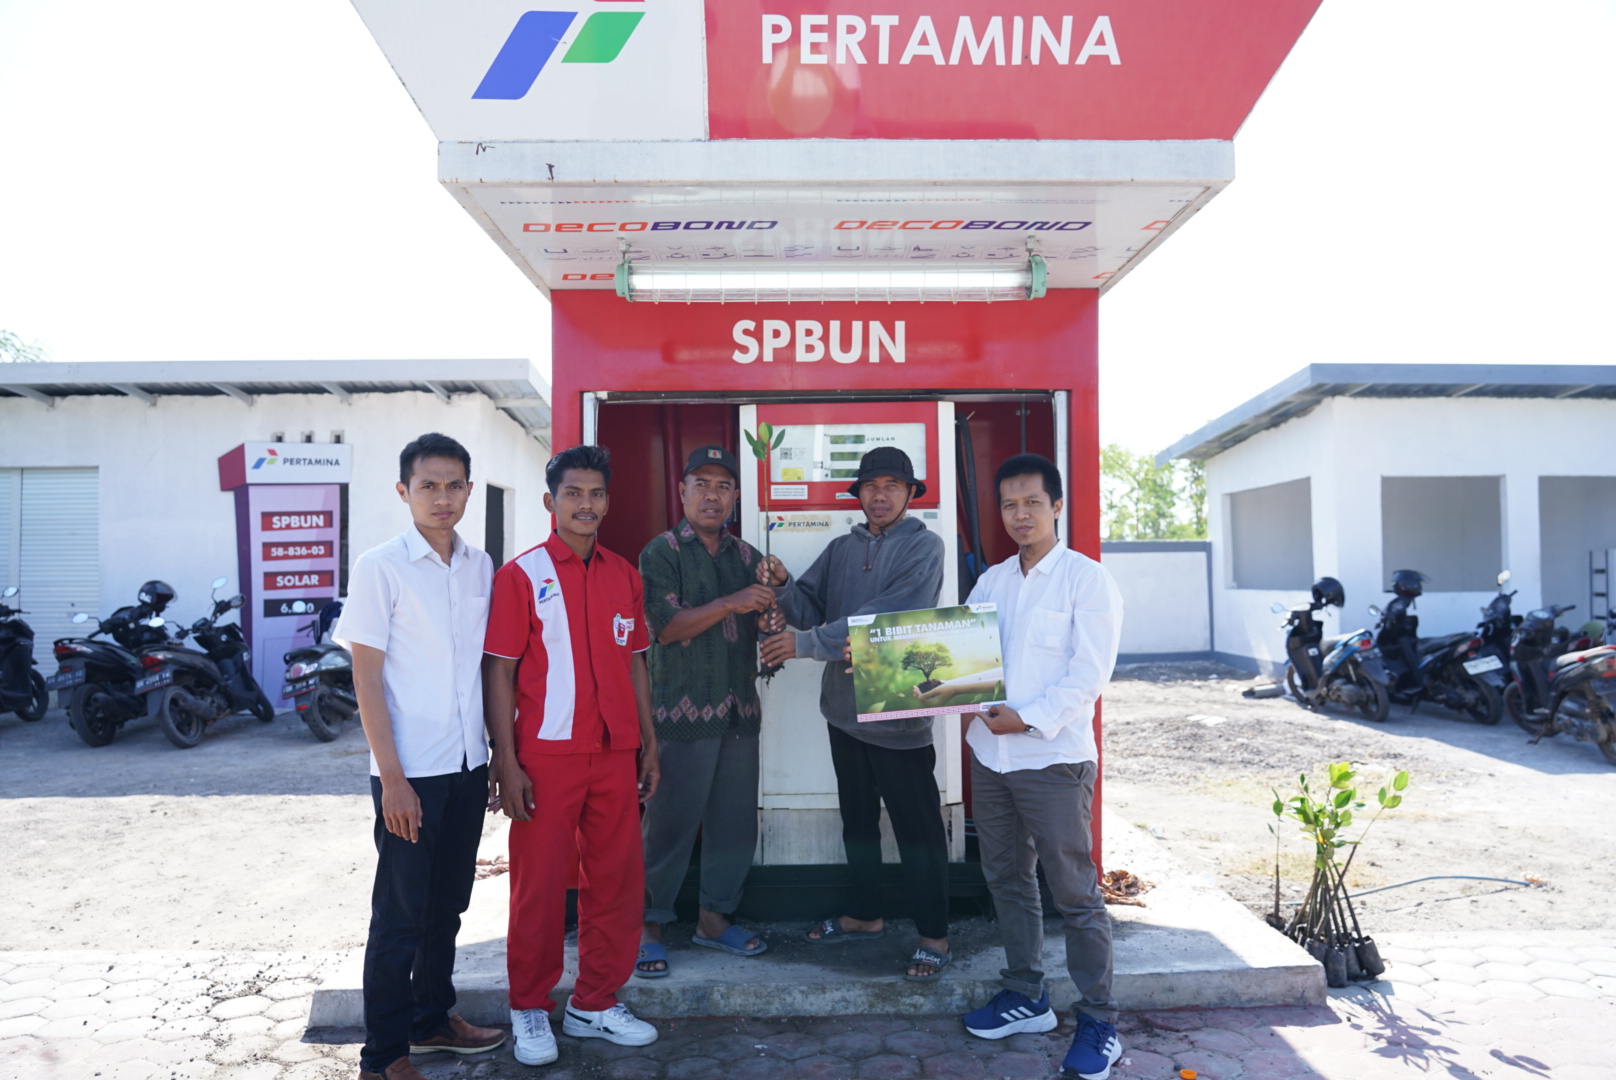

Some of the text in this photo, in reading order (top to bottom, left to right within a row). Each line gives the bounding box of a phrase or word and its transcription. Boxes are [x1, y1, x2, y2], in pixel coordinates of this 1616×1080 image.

[761, 14, 1122, 66] PERTAMINA
[731, 319, 906, 364] SPBUN
[283, 457, 340, 466] PERTAMINA
[272, 514, 325, 529] SPBUN
[270, 545, 325, 557] 58-836-03
[276, 574, 320, 587] SOLAR
[280, 602, 315, 614] 6.0
[885, 624, 912, 636] BIBIT
[870, 635, 893, 643] UNTUK
